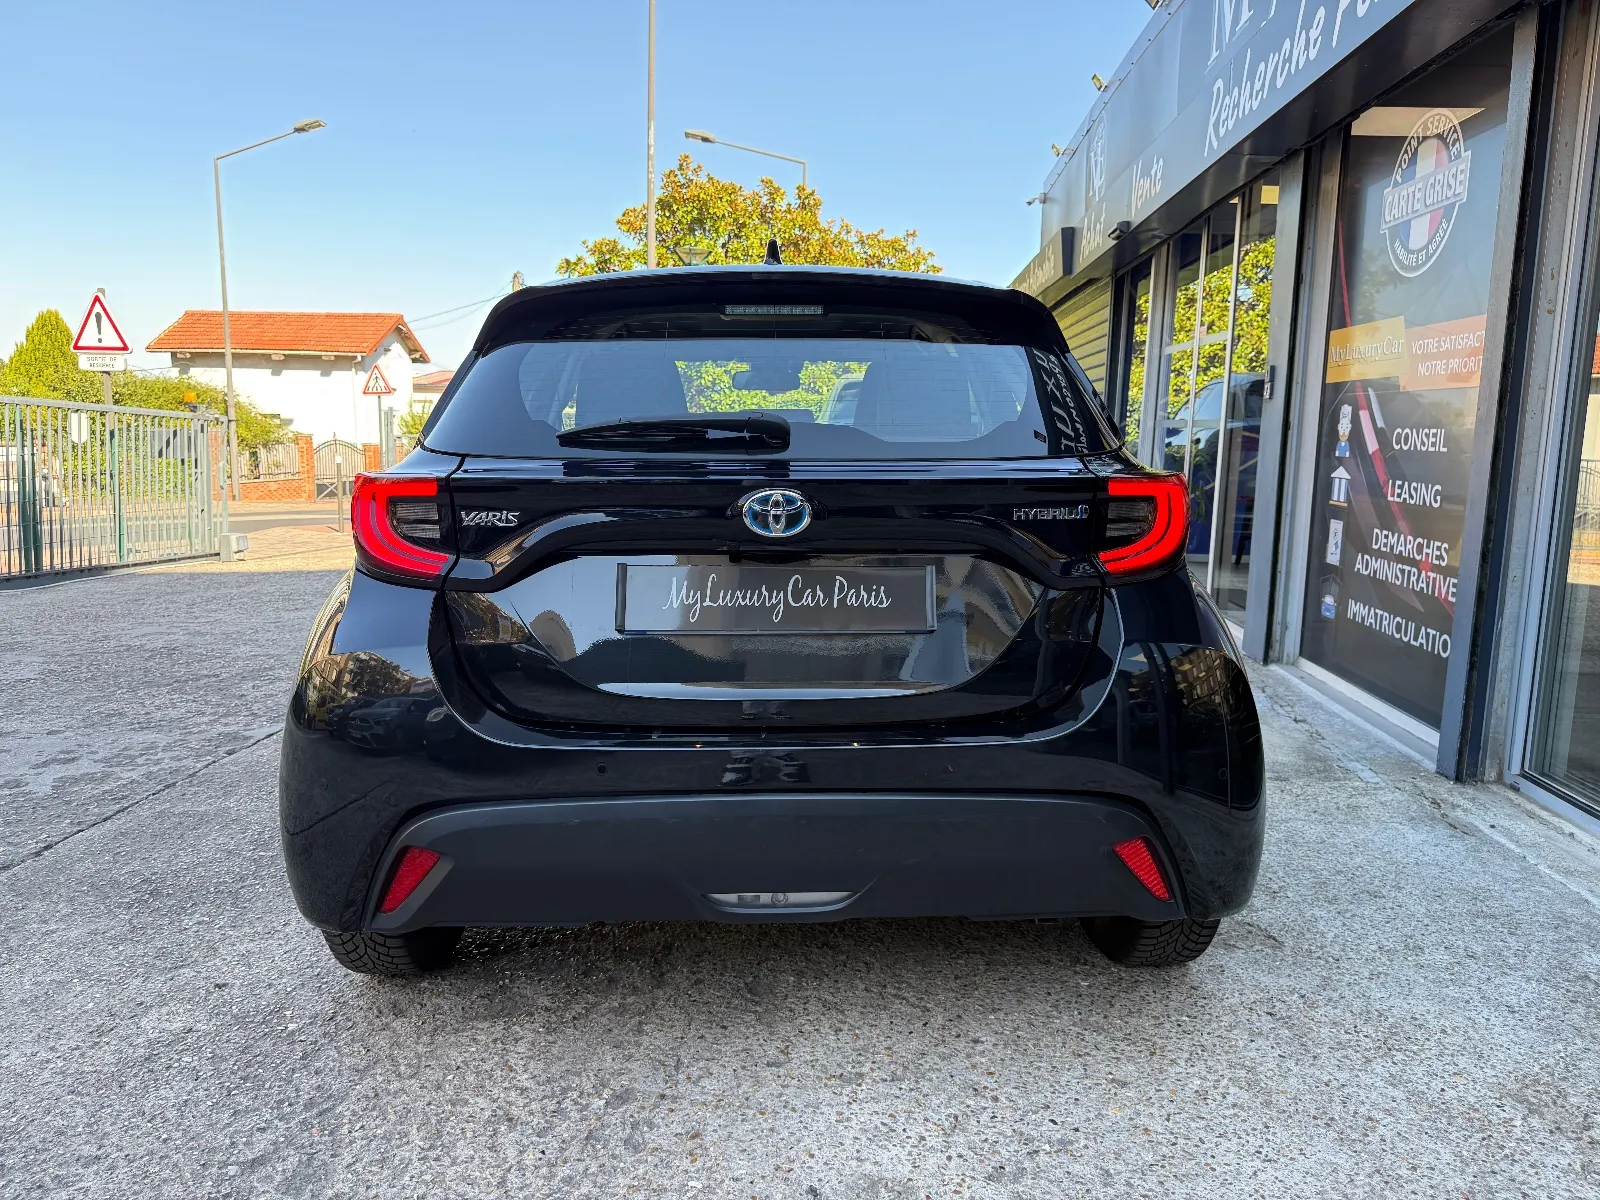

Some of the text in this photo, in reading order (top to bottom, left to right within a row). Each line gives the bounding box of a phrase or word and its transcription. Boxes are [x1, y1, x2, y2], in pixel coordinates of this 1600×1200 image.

[1204, 0, 1326, 157] Recherche
[1395, 115, 1461, 183] POINT SERVICE
[1131, 154, 1163, 219] Vente
[1384, 163, 1467, 223] CARTE GRISE
[1418, 252, 1427, 265] ET
[1329, 336, 1404, 366] MyLuxuryCar
[1411, 330, 1486, 356] VOTRE SATISFACT
[1417, 355, 1483, 377] NOTRE PRIORIT
[1392, 427, 1448, 453] CONSEIL
[1387, 479, 1442, 508] LEASING
[460, 510, 521, 527] YARIS
[1013, 507, 1078, 521] HYBRID
[1371, 528, 1449, 567] DEMARCHES
[833, 575, 892, 609] Paris
[1354, 552, 1458, 602] ADMINISTRATIVE
[1347, 598, 1451, 658] IMMATRICULATIO
